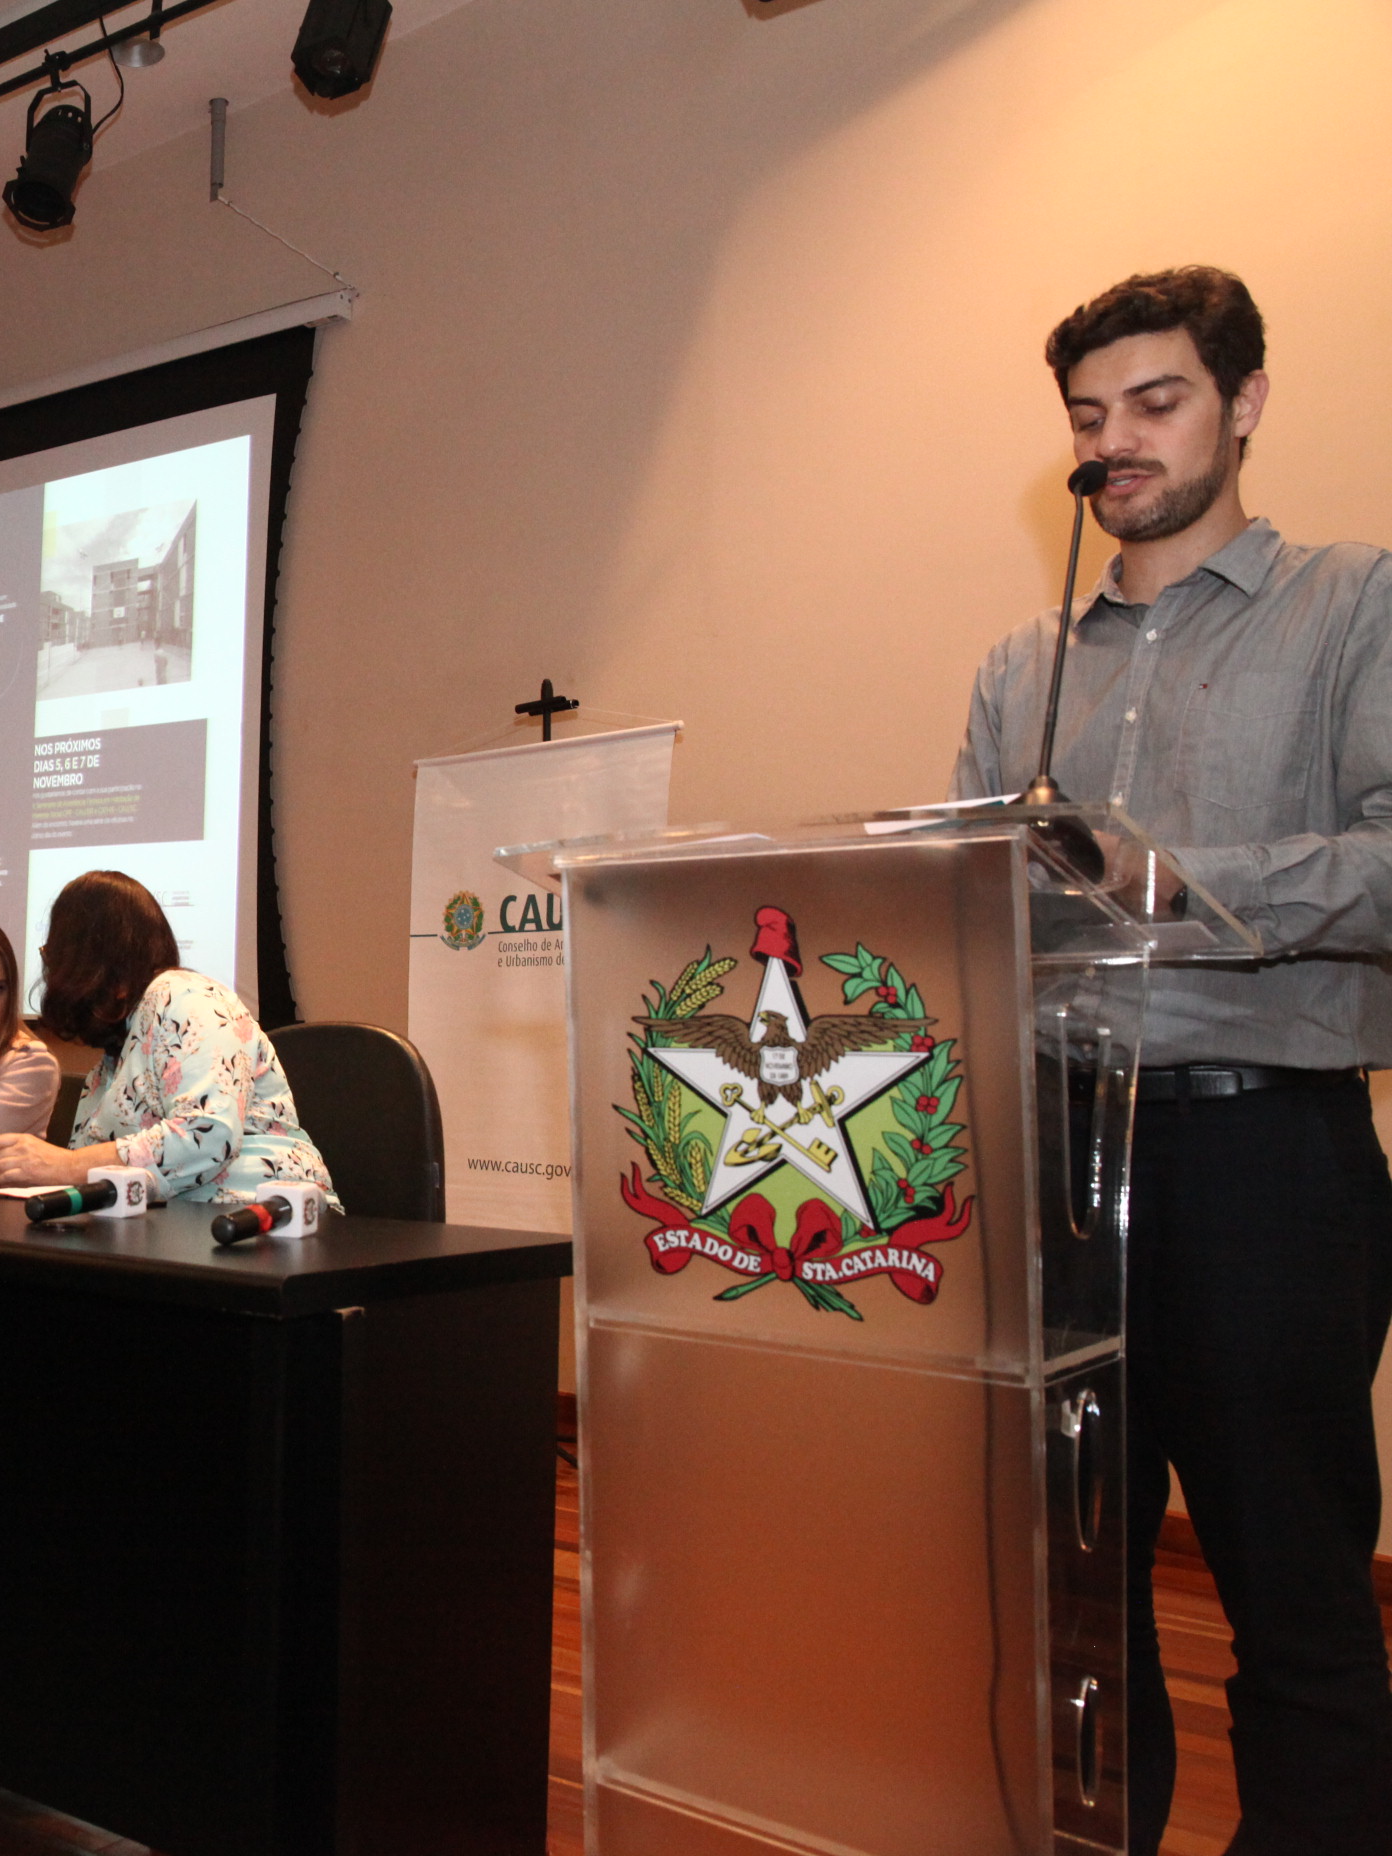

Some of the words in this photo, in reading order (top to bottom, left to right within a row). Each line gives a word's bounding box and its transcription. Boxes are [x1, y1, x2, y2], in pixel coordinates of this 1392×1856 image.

[34, 743, 53, 756] NOS
[54, 738, 101, 755] PRÓXIMOS
[33, 759, 54, 773] DIAS
[55, 758, 63, 772] 5,
[64, 757, 71, 770] 6
[72, 757, 78, 769] E
[80, 756, 86, 769] 7
[87, 754, 100, 768] DE
[33, 773, 84, 789] NOVEMBRO
[499, 893, 563, 932] CAU
[498, 938, 538, 953] Conselho
[541, 938, 552, 951] de
[497, 957, 503, 967] e
[505, 953, 553, 968] Urbanismo
[467, 1158, 572, 1181] www.causc.gov
[653, 1230, 733, 1262] ESTADO
[732, 1251, 762, 1273] DE
